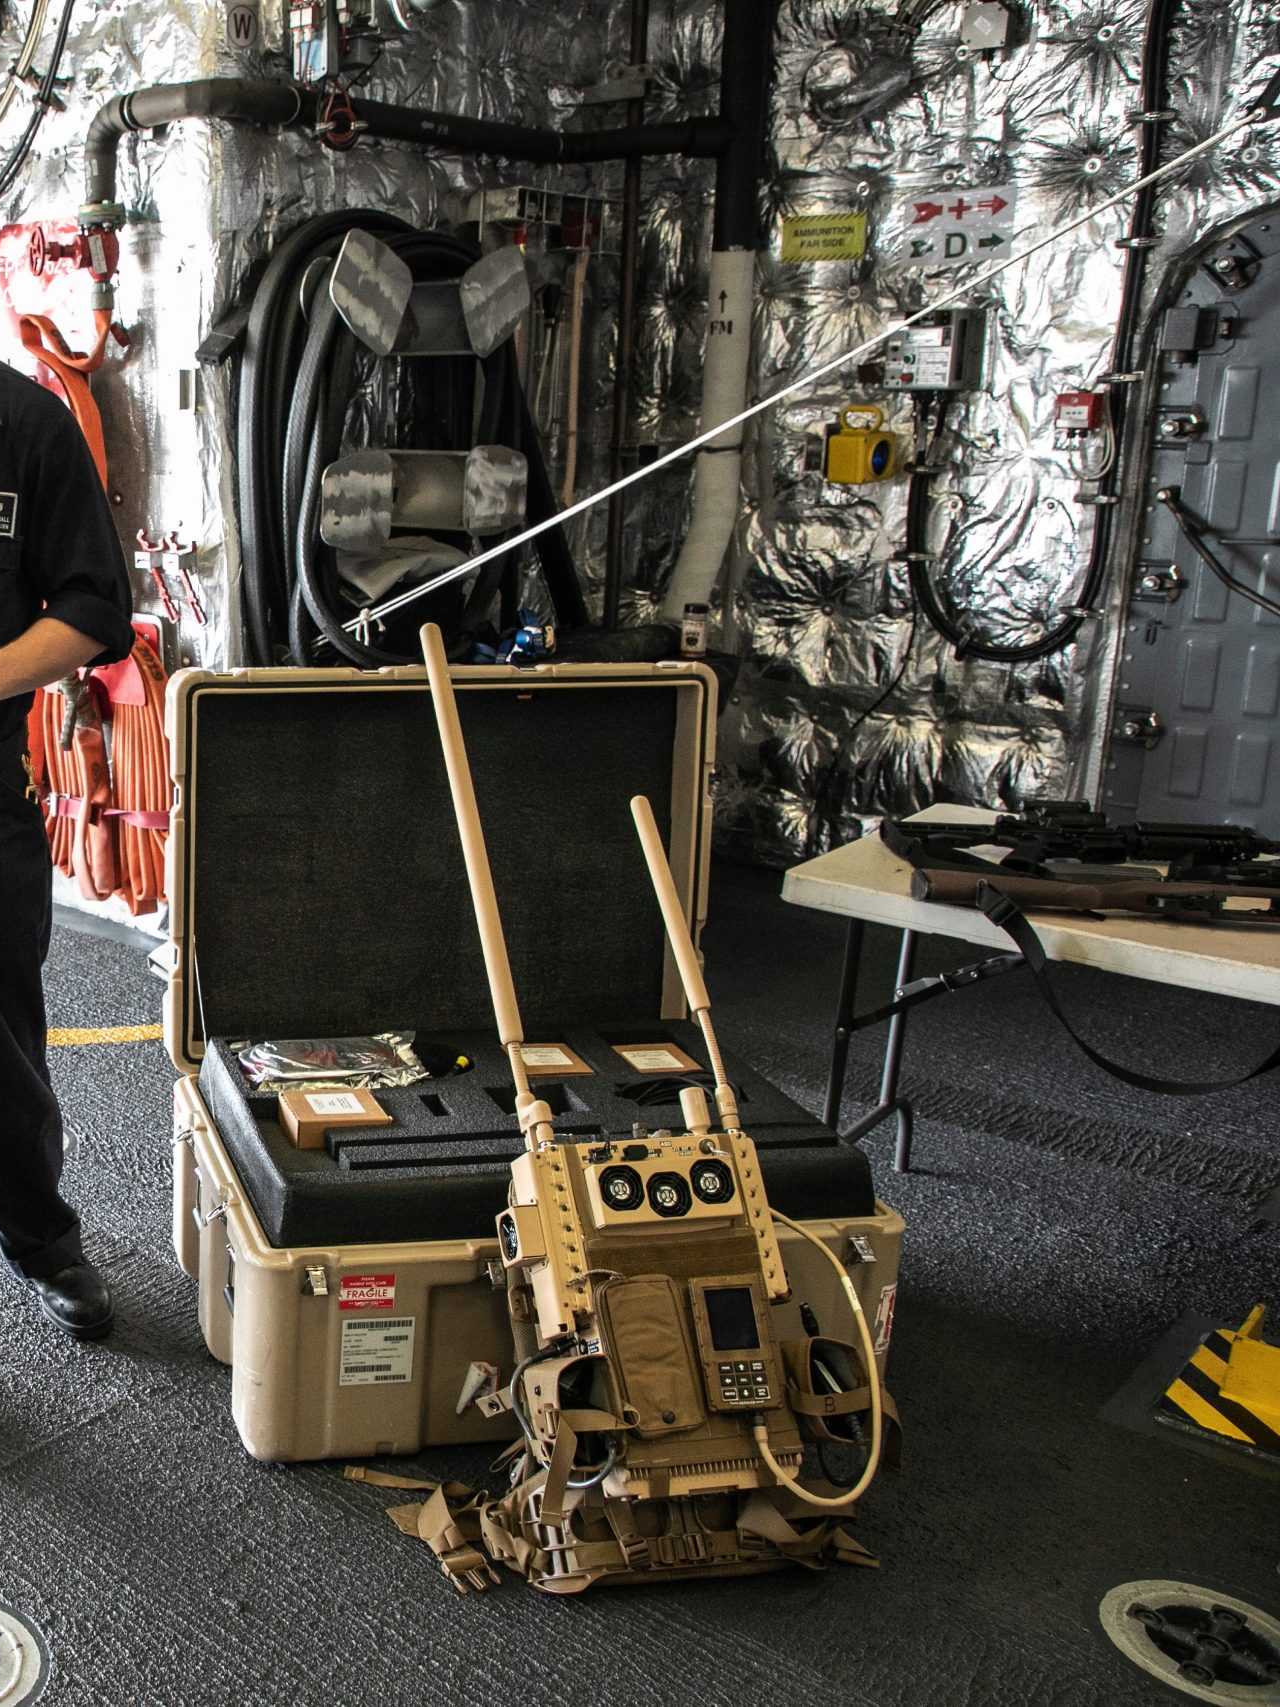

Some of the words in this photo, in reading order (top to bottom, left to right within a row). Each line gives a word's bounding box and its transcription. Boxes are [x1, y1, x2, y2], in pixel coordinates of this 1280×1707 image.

[233, 13, 252, 40] W
[793, 226, 855, 238] AMMUNITION
[800, 239, 820, 248] FAR
[822, 237, 845, 247] SIDE
[944, 232, 968, 259] D
[710, 320, 733, 336] FM
[346, 1289, 388, 1298] FRAGILE
[824, 1396, 836, 1413] B
